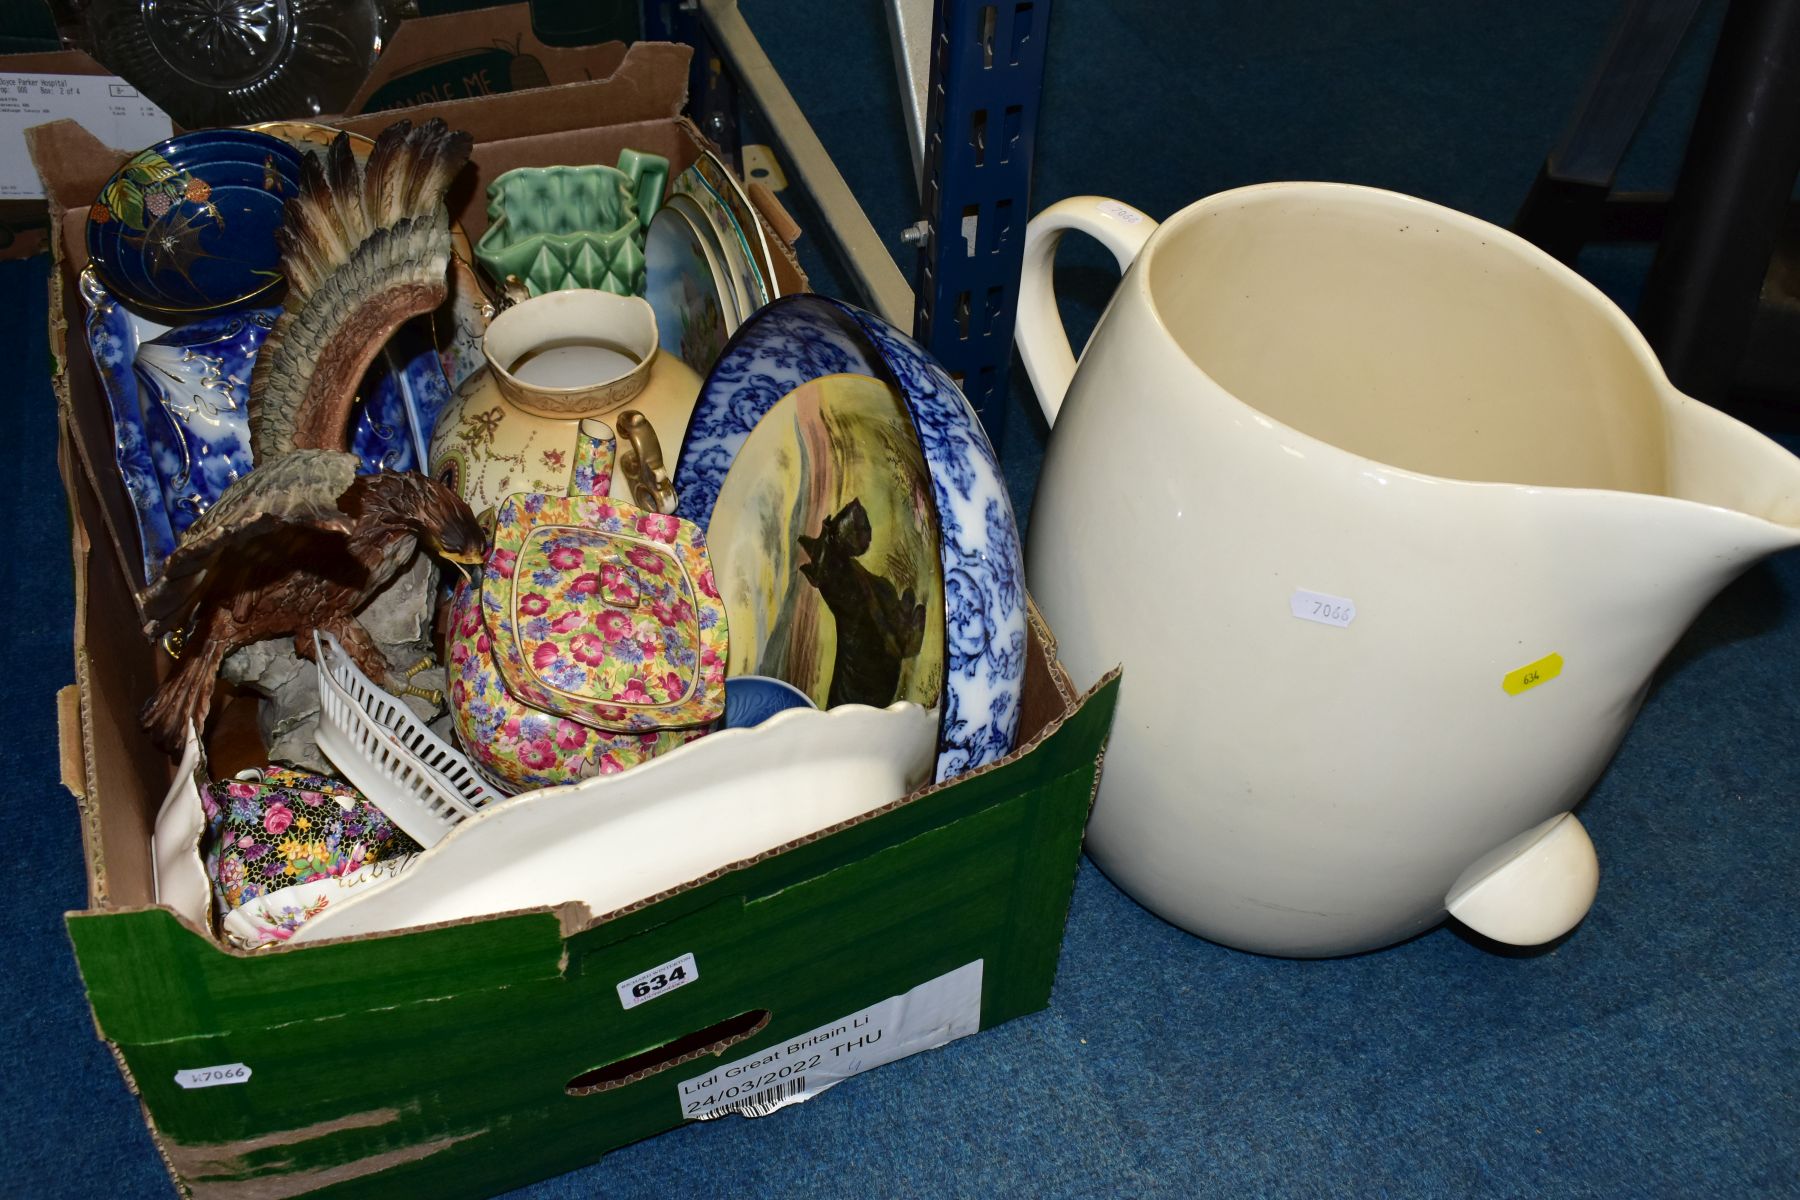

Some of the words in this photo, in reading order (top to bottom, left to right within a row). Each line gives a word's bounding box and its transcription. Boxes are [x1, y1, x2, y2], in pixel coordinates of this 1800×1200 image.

[41, 79, 68, 88] Hospital
[463, 68, 494, 98] ME
[1312, 601, 1350, 621] 7066
[1523, 670, 1539, 685] 634
[632, 966, 686, 998] 634
[684, 1075, 718, 1095] Lidl
[725, 1051, 780, 1078] Great
[787, 1025, 847, 1055] Britain
[853, 1015, 870, 1030] Li
[687, 1054, 822, 1114] 24/03/2022
[830, 1029, 883, 1057] THU
